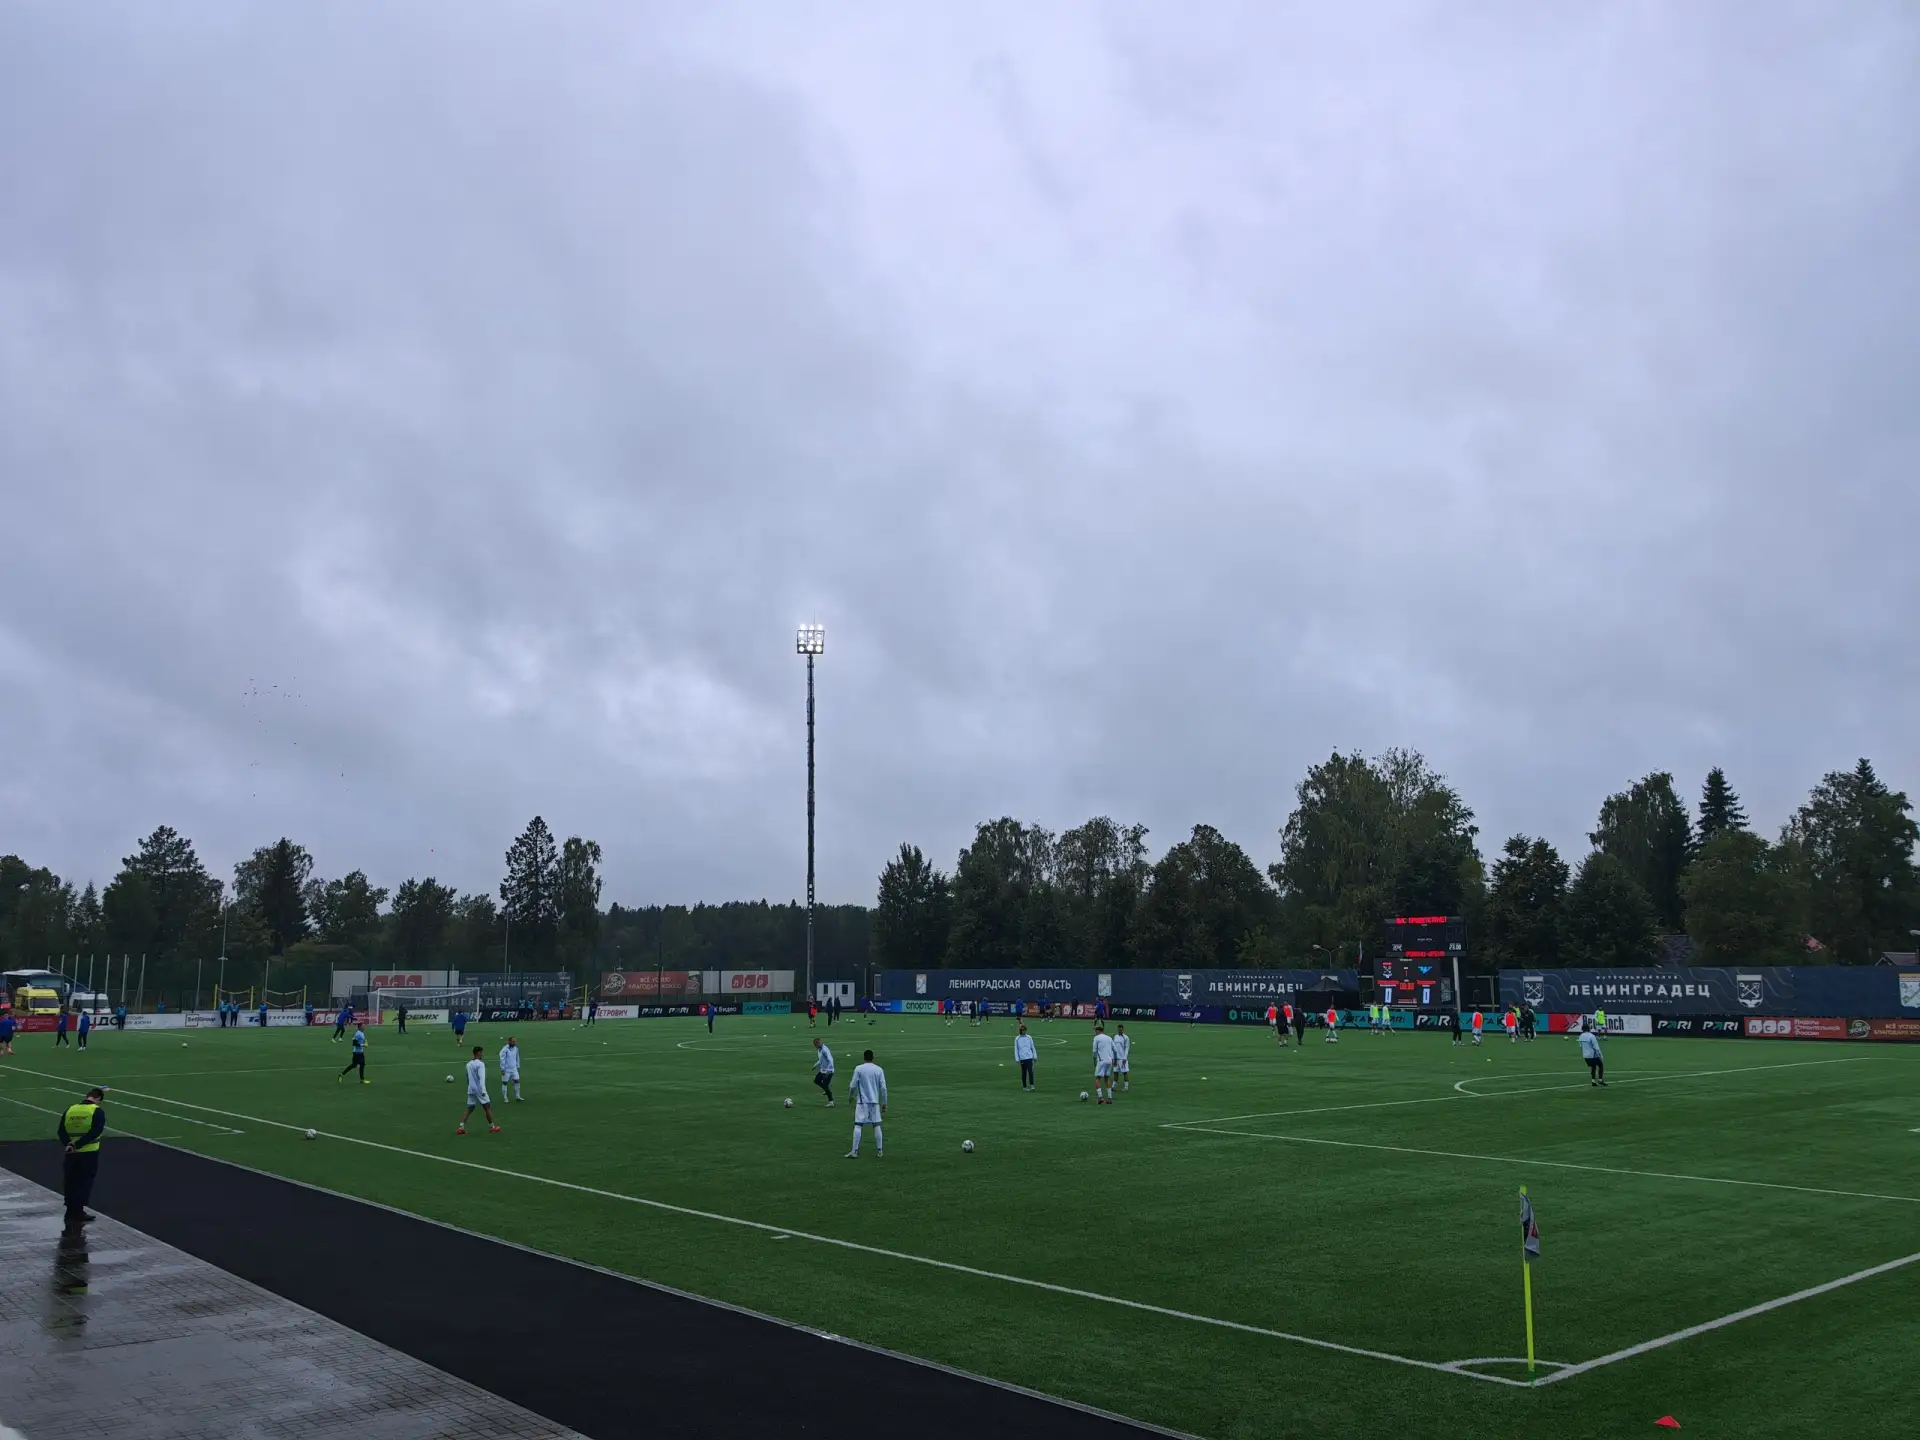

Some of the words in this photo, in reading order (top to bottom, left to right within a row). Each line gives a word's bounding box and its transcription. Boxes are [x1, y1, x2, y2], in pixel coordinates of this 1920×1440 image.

[949, 979, 1020, 990] ЛЕНИНГРАДСКАЯ
[1028, 979, 1071, 990] ОБЛАСТЬ
[1569, 984, 1710, 998] ЛЕНИНГРАДЕЦ
[491, 1011, 519, 1019] PARI
[641, 1007, 663, 1015] PARI
[1112, 1007, 1131, 1016] PARI
[1136, 1008, 1156, 1016] PARI
[1657, 1020, 1692, 1030] PARI
[1702, 1021, 1739, 1031] PARI
